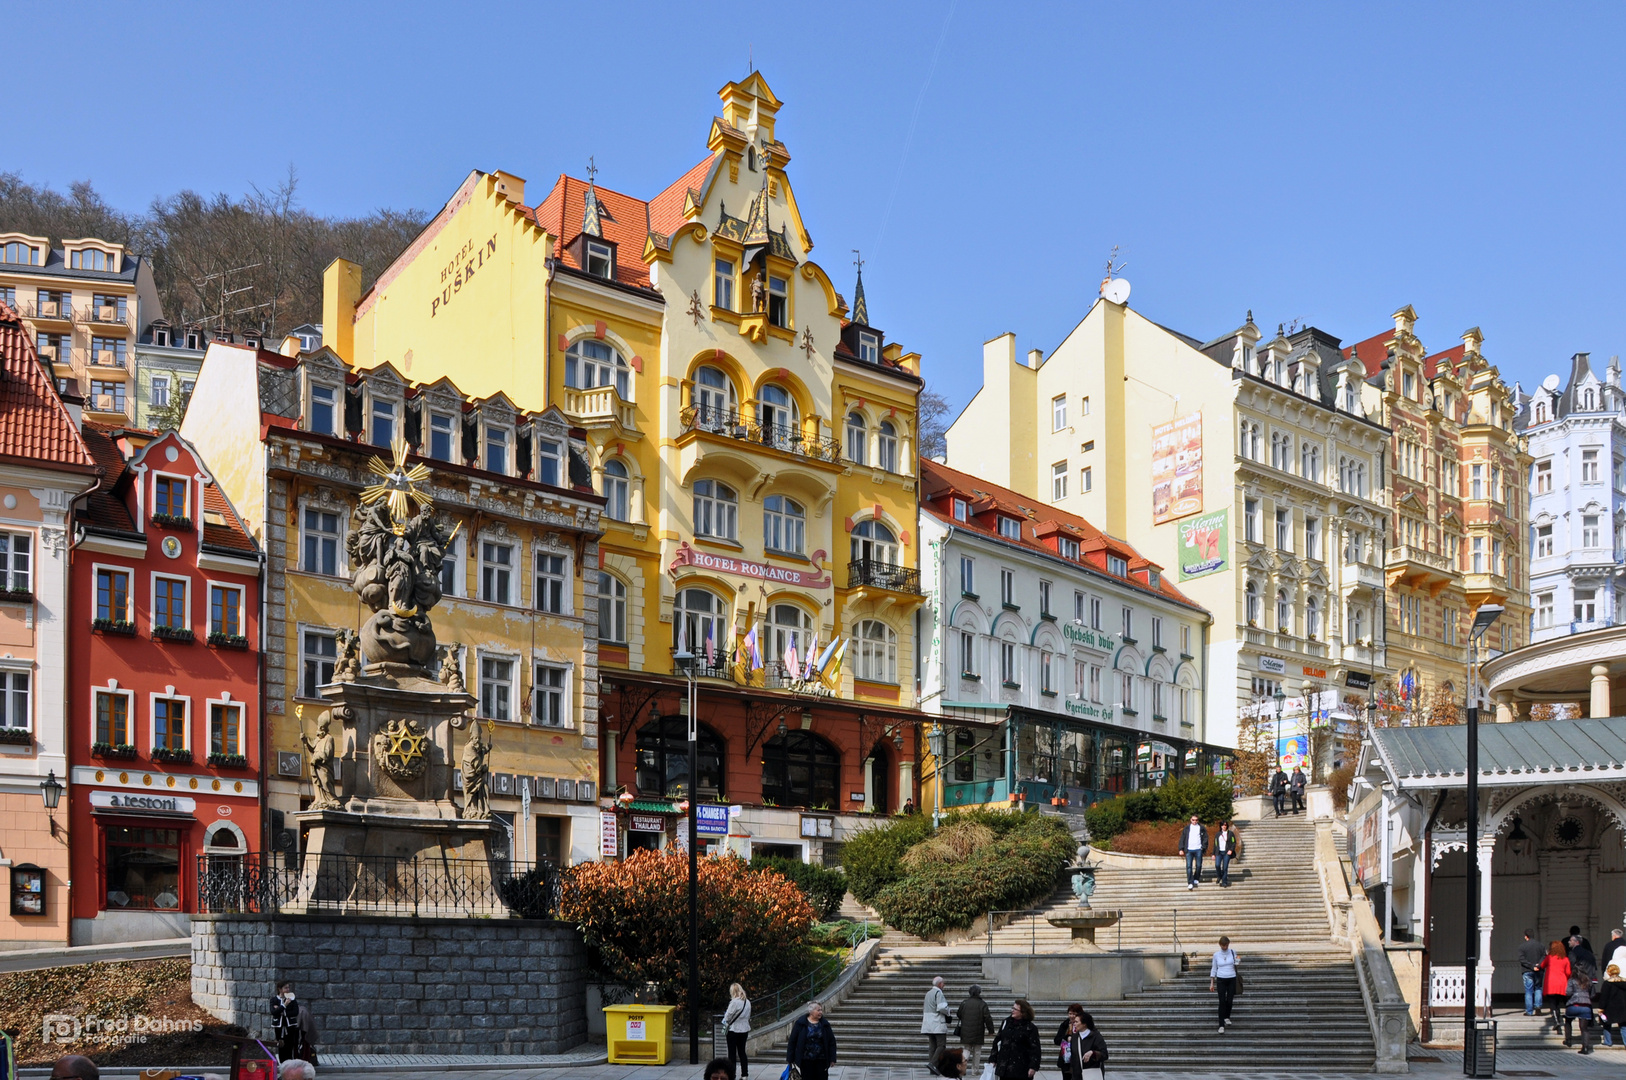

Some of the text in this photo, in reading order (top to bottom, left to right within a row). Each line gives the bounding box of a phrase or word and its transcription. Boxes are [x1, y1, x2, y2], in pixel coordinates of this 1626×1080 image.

[441, 238, 475, 284] HOTEL
[1180, 514, 1225, 534] Merino
[1182, 522, 1224, 539] AUSTRALIA
[694, 553, 801, 583] HOTEL ROMANCE
[1065, 699, 1100, 718] Egerländer
[110, 794, 177, 811] a.testoni
[633, 816, 662, 825] RESTAURANT
[702, 806, 720, 820] CHANGE
[635, 822, 661, 831] THAILAND
